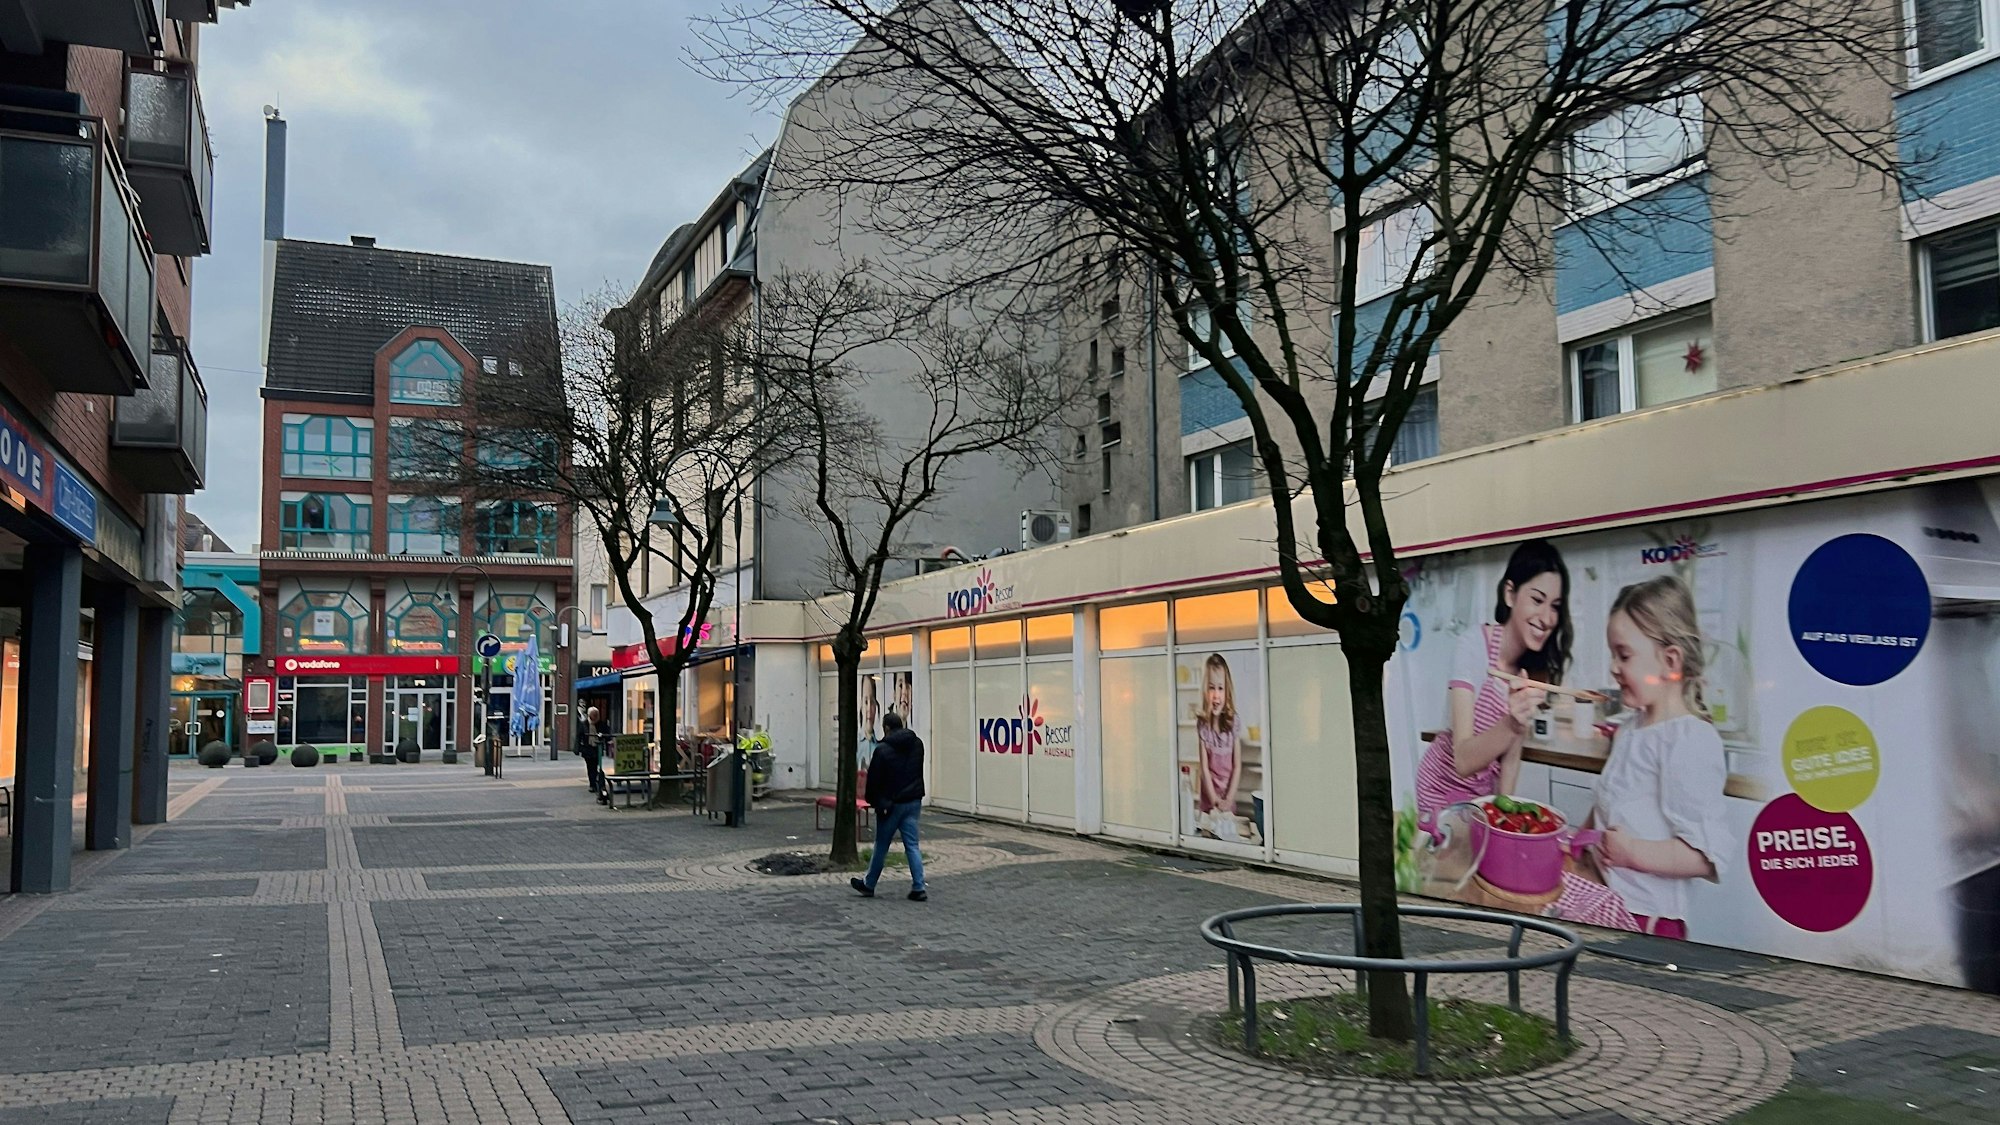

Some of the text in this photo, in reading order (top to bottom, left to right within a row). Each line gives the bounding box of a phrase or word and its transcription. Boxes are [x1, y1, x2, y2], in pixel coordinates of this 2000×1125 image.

[1801, 631, 1918, 647] AUF DAS VERLASS IST
[298, 659, 340, 669] vodafone
[1045, 724, 1072, 745] Besser
[1756, 826, 1857, 853] PREISE,
[1760, 854, 1859, 871] DIE SICH JEDER
